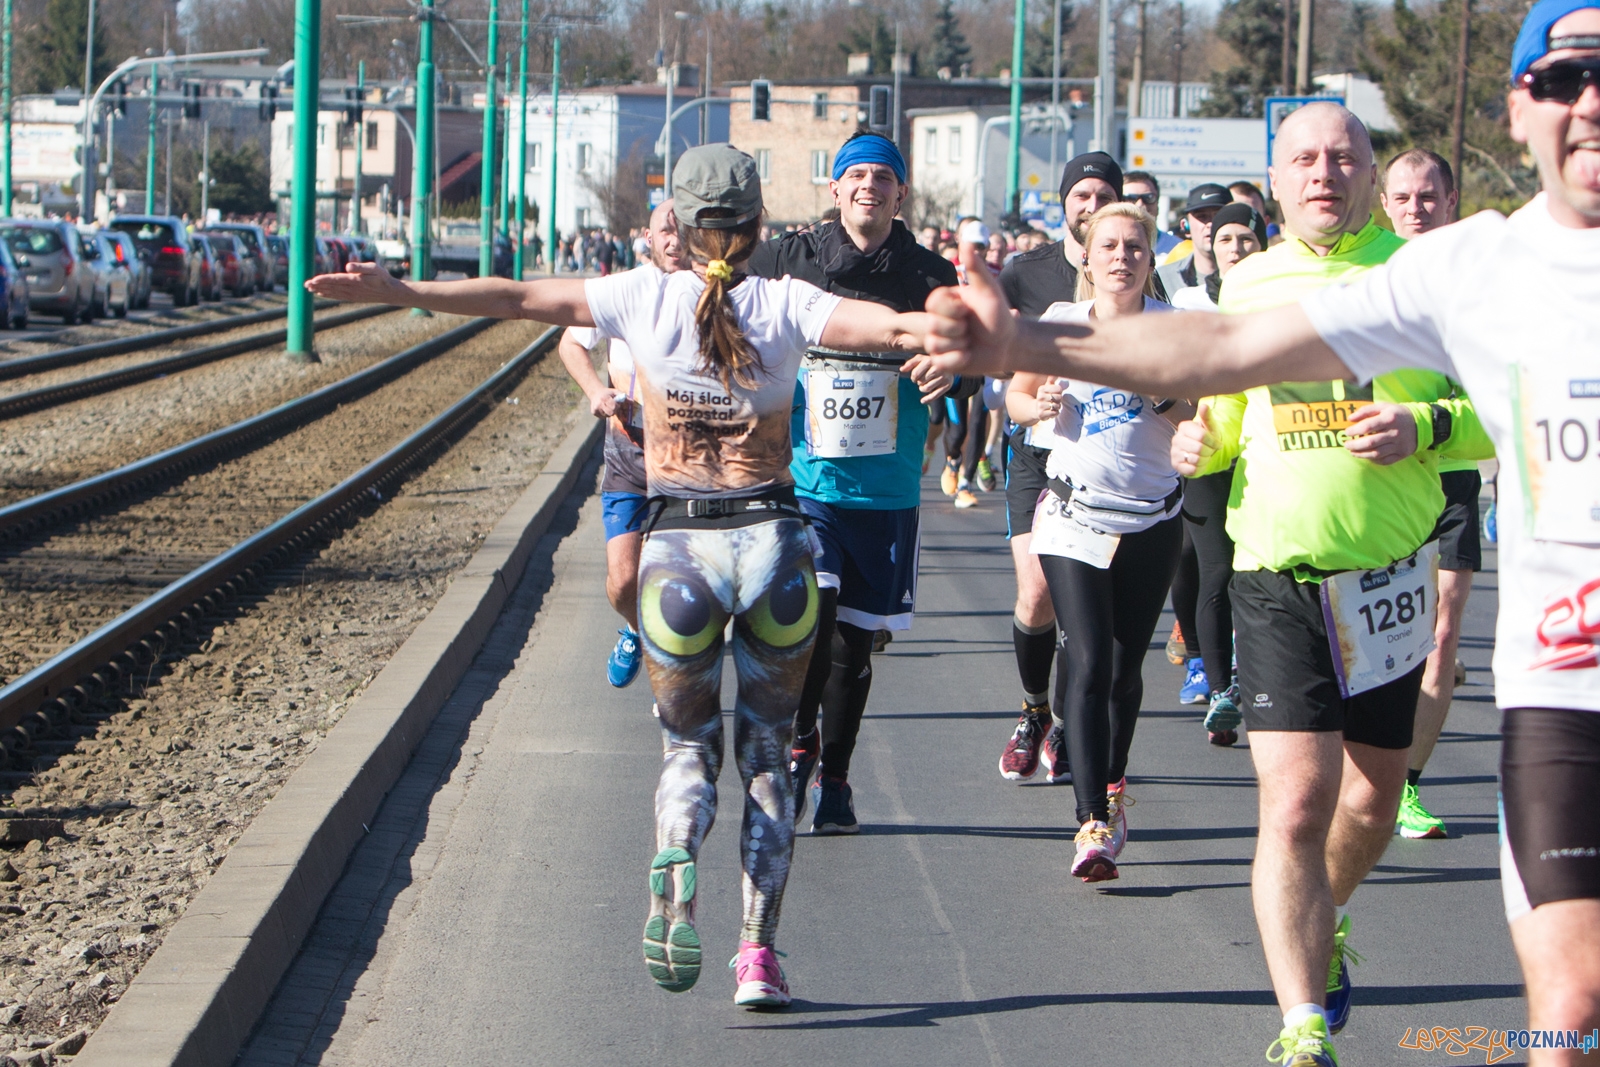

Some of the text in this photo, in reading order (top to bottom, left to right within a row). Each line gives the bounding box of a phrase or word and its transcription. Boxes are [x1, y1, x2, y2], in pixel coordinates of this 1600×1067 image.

[666, 389, 732, 406] Mój ślad
[823, 396, 885, 420] 8687
[1074, 390, 1143, 420] WILDA
[667, 407, 734, 421] pozostał
[1292, 403, 1357, 428] night
[1536, 418, 1600, 463] 10
[1358, 584, 1425, 636] 1281
[1386, 626, 1413, 644] Daniel
